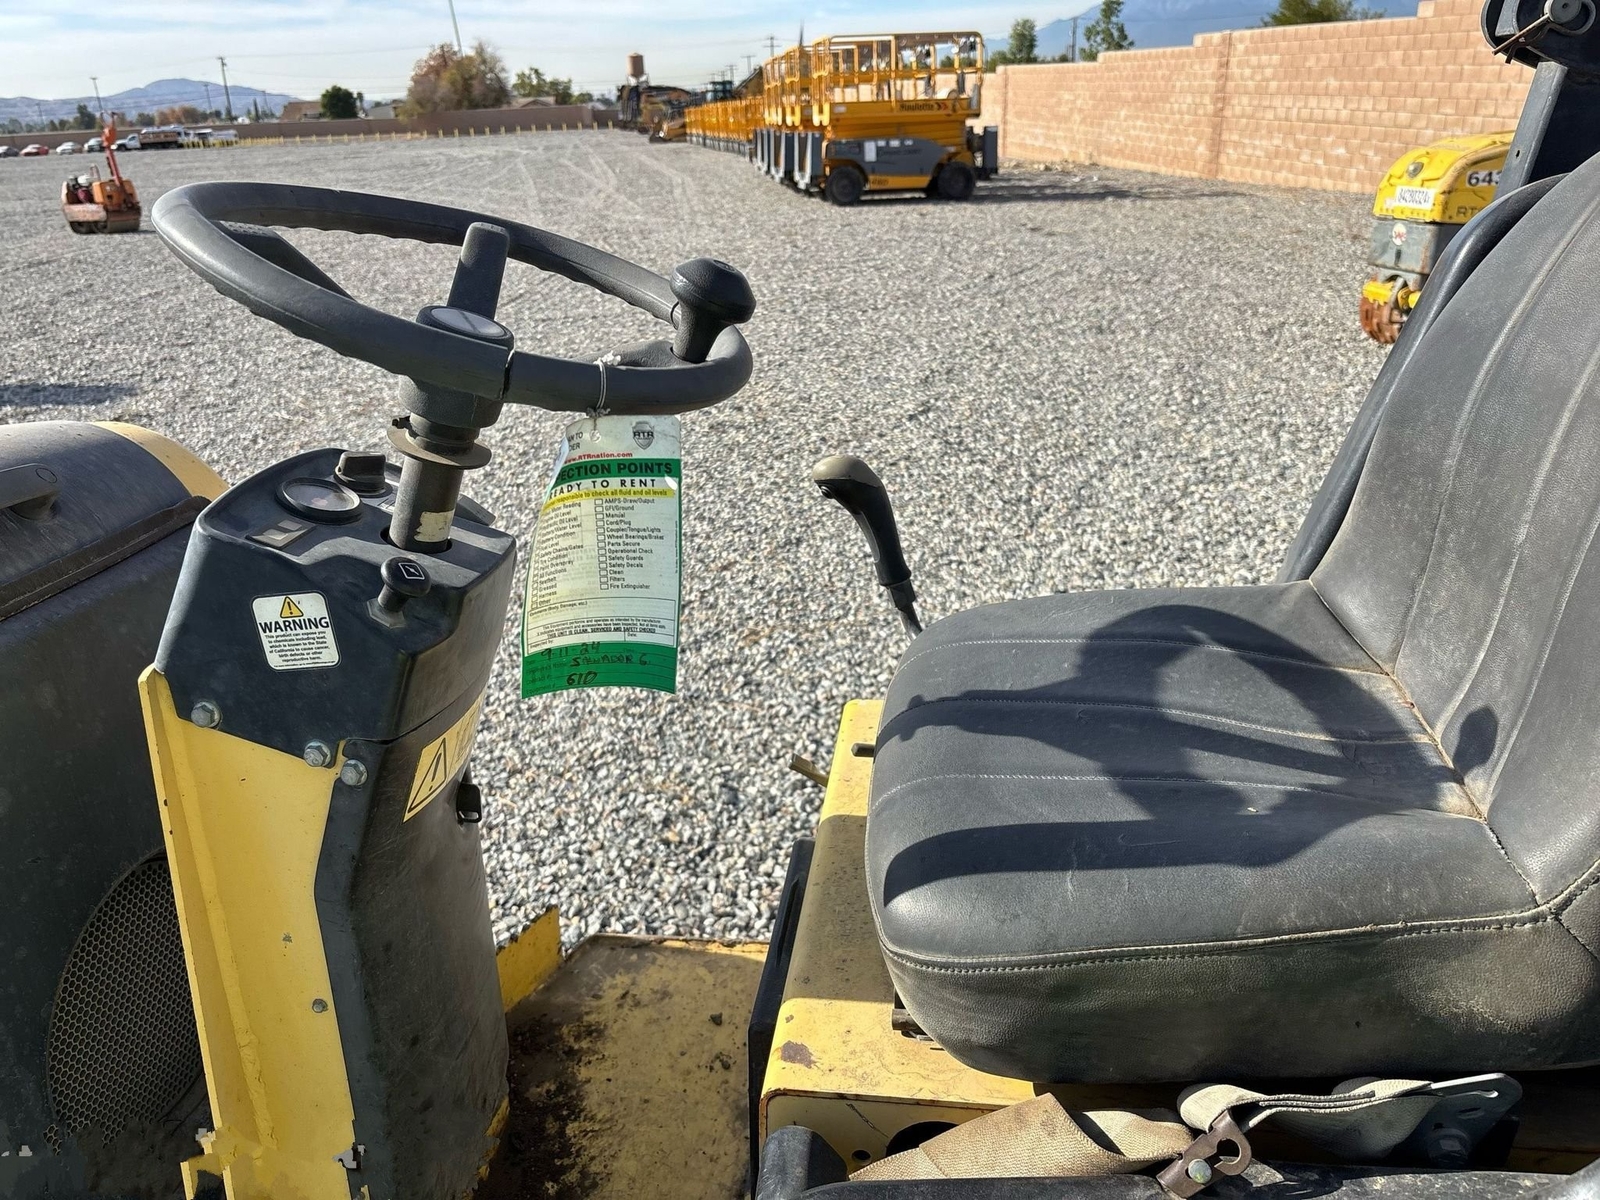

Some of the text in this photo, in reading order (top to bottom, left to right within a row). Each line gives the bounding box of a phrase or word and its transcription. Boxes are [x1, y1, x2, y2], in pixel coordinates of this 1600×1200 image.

[576, 432, 583, 440] TO
[618, 462, 672, 475] POINTS
[592, 480, 610, 488] TO
[620, 479, 656, 488] RENT
[592, 489, 610, 497] check
[259, 617, 330, 634] WARNING
